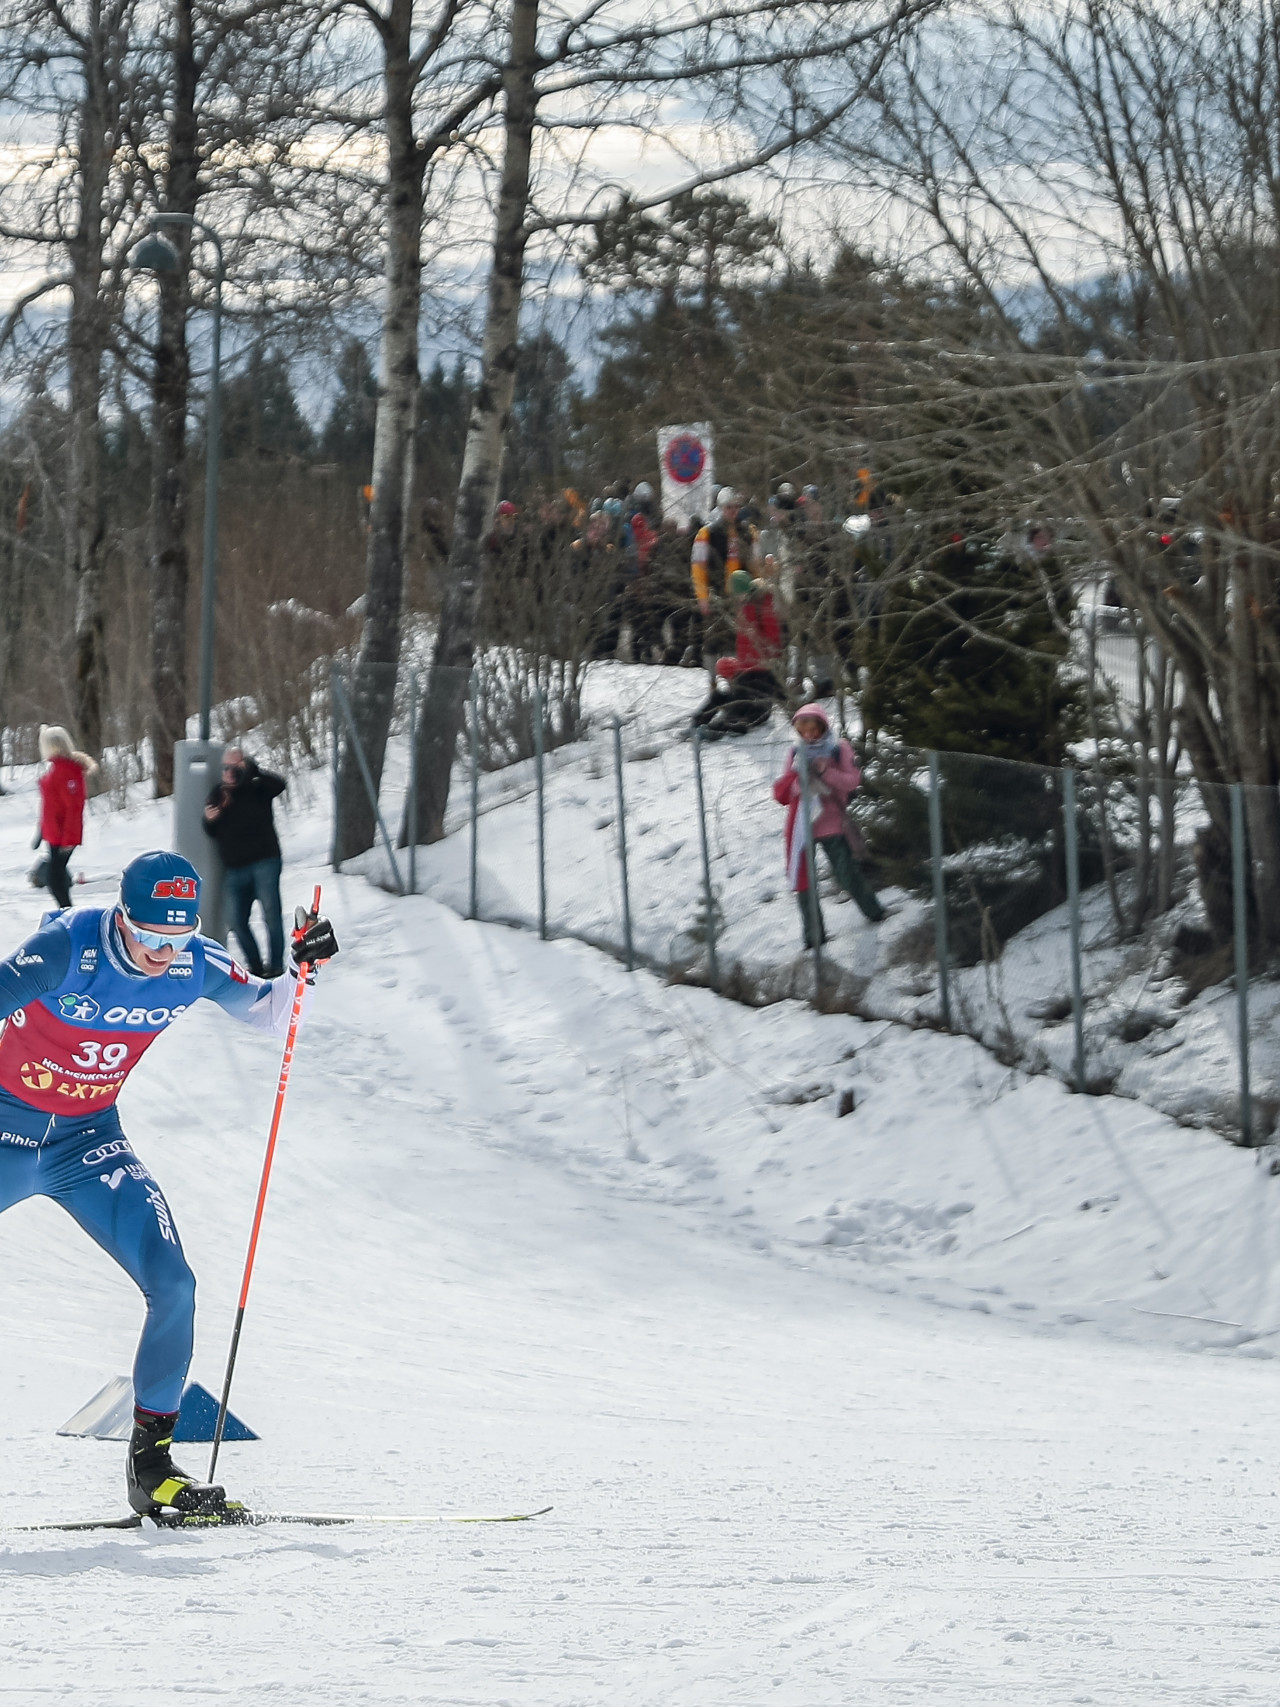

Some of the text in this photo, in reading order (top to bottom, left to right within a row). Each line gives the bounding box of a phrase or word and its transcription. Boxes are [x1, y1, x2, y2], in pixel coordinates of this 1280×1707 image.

[168, 967, 192, 976] coop
[71, 1041, 128, 1071] 39
[1, 1131, 39, 1148] Pihla
